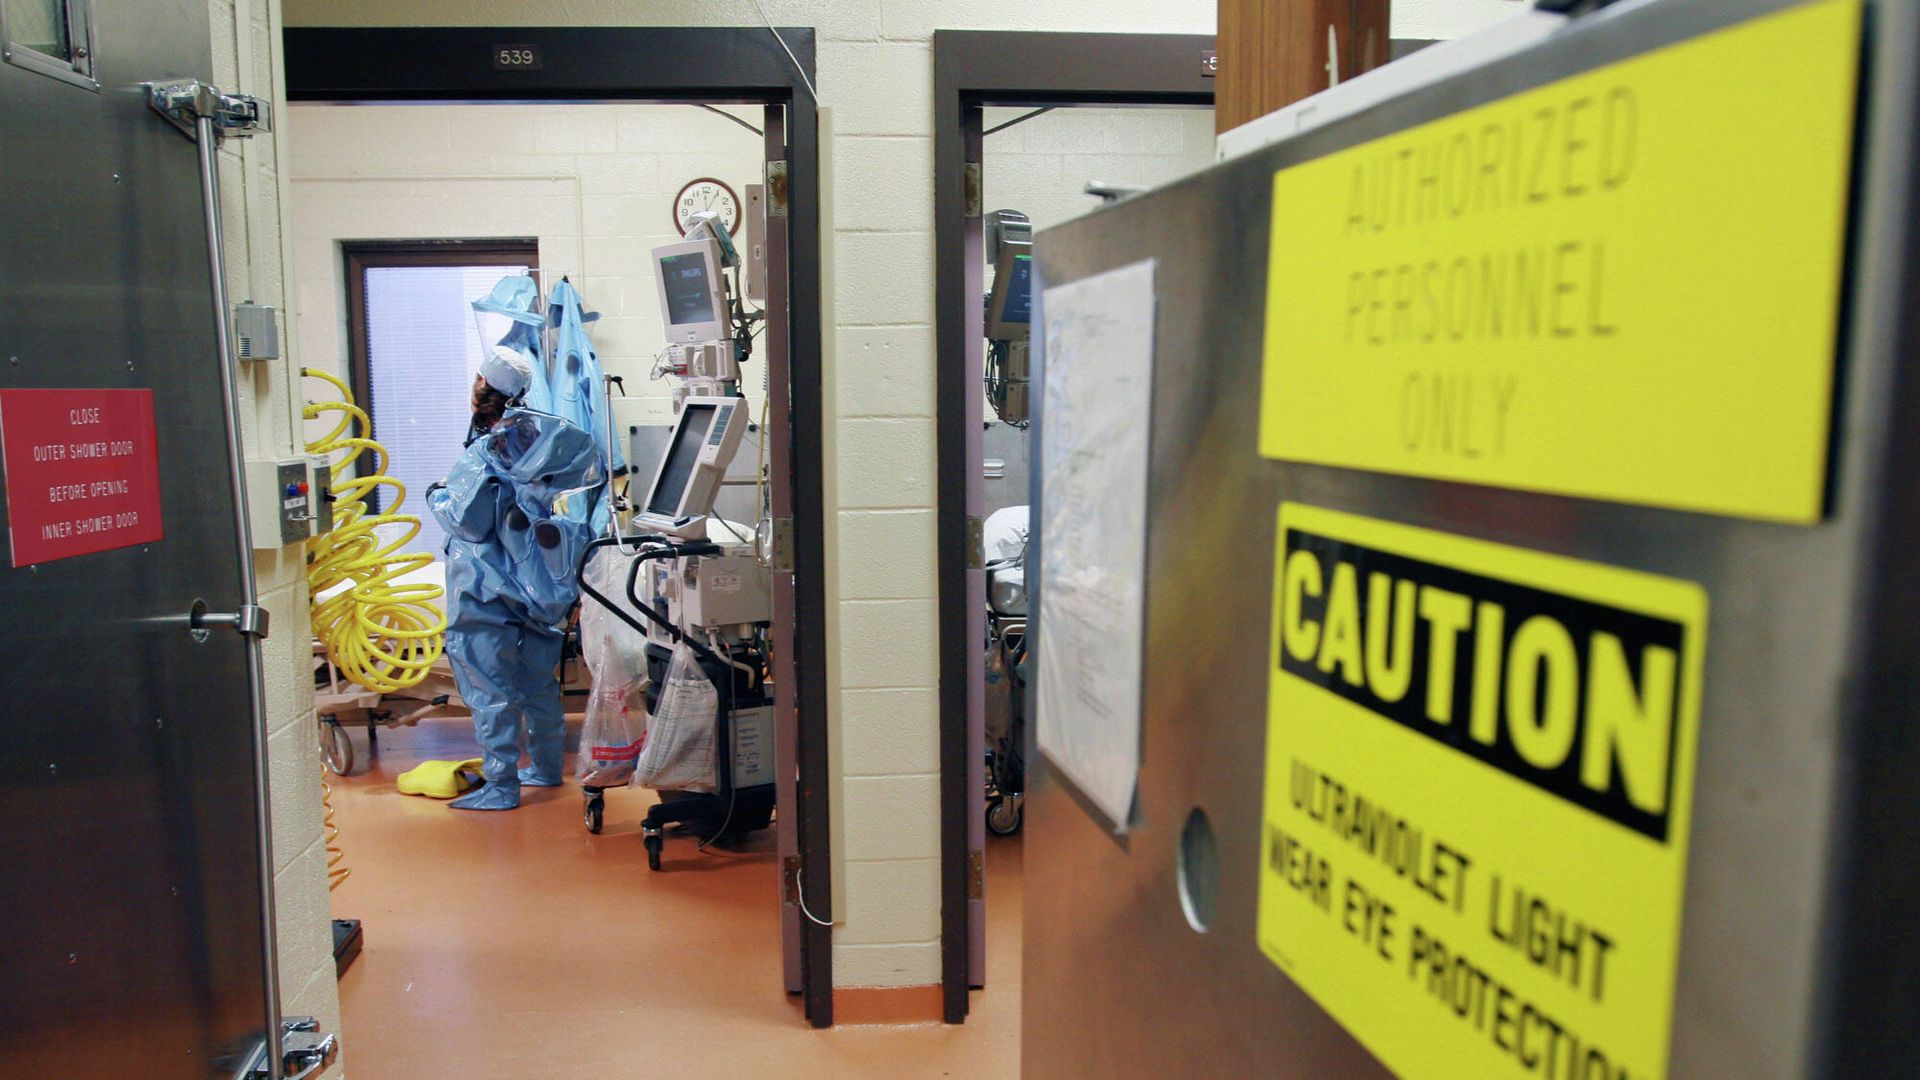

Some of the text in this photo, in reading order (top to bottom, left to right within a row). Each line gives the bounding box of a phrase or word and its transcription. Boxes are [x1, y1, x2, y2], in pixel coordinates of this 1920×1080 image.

[500, 50, 533, 64] 539
[1344, 85, 1640, 235] AUTHORIZED
[682, 208, 688, 216] 9
[684, 198, 693, 206] 10
[722, 197, 729, 205] 2
[1344, 240, 1620, 345] PERSONNEL
[70, 407, 101, 426] CLOSE
[1401, 371, 1519, 459] ONLY
[33, 440, 134, 462] OUTER SHOWER DOOR
[49, 479, 129, 502] BEFORE OPENING
[42, 511, 139, 540] INNER SHOWER DOOR
[1282, 549, 1679, 817] CAUTION
[1289, 756, 1617, 1004] ULTRAVIOLET LIGHT
[1267, 822, 1628, 1080] WEAR EYE PROTECTI
